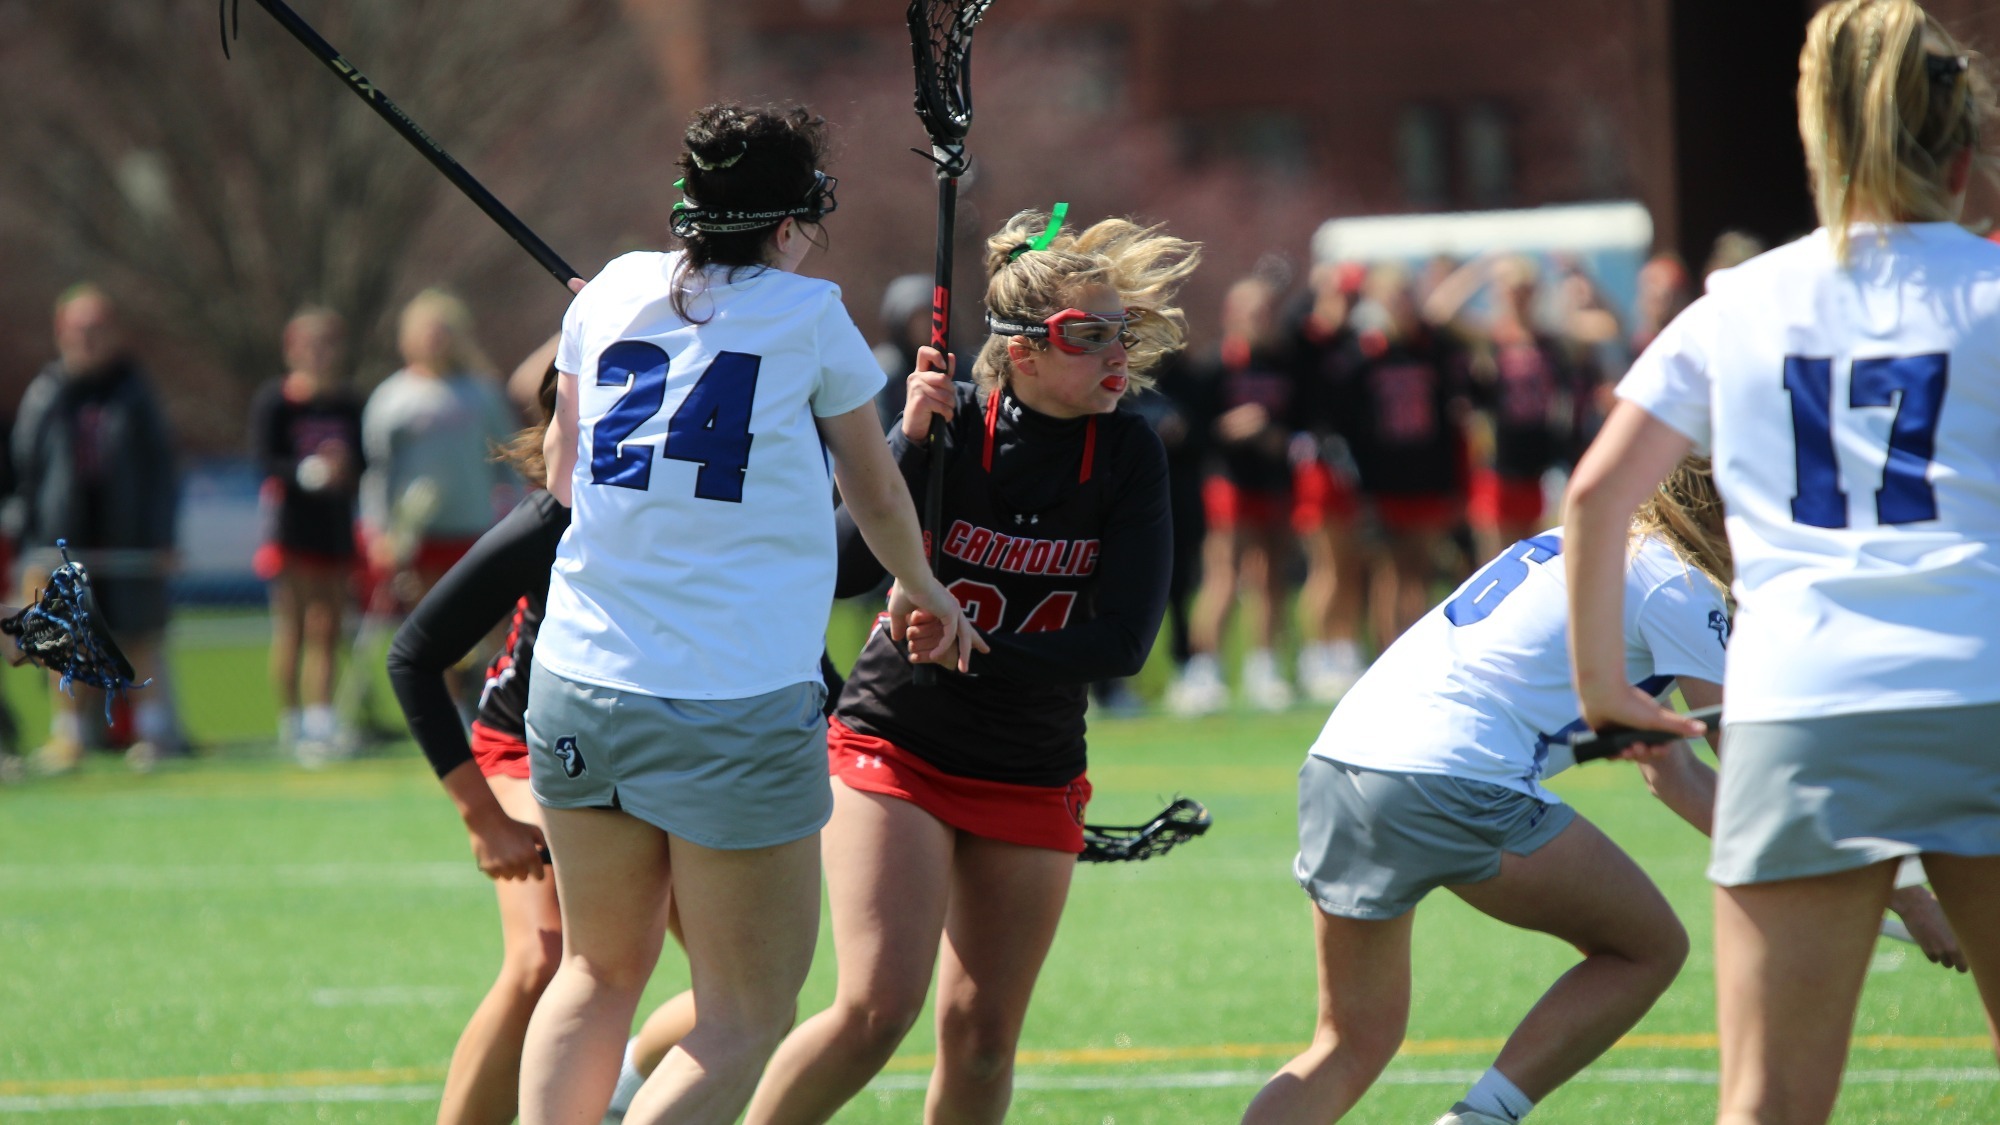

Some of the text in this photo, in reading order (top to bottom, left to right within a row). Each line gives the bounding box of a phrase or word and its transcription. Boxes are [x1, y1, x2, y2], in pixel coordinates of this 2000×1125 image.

[331, 55, 375, 99] STX
[746, 209, 786, 219] UNDER
[932, 285, 949, 349] STX
[591, 340, 762, 503] 24
[1783, 352, 1949, 529] 17
[942, 519, 1100, 576] CATHOLIC
[1444, 535, 1563, 627] 6
